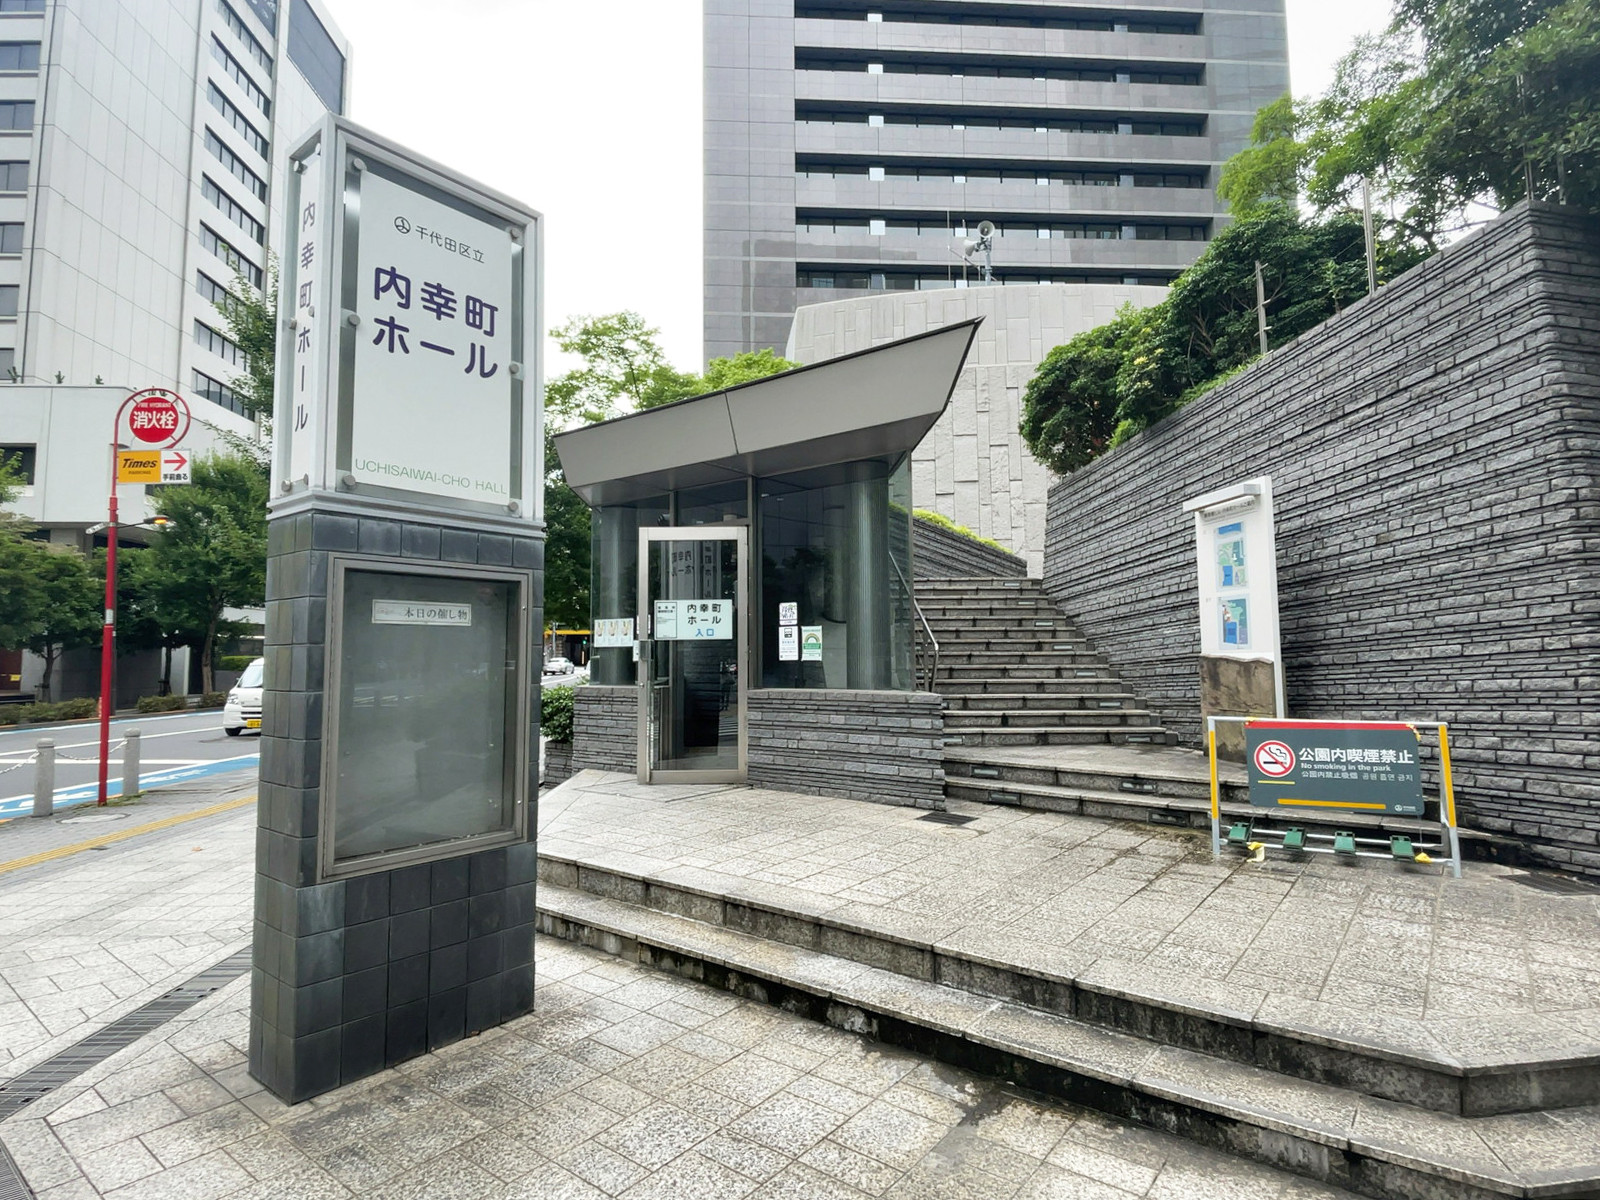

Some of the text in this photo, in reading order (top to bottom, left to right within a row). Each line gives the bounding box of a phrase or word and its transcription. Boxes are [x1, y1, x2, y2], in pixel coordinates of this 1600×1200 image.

[414, 224, 485, 264] 千代田区立
[373, 265, 499, 338] 内幸町
[294, 201, 316, 432] 内幸町ホール
[372, 315, 499, 379] ホール
[133, 410, 176, 429] 消火栓
[122, 458, 158, 469] Times
[354, 458, 508, 495] UCHISAIWAI-CHO HALL
[404, 606, 468, 620] 本日の催し物
[687, 603, 721, 614] 内幸町
[687, 616, 722, 625] ホール
[695, 628, 715, 637] 入口
[1298, 748, 1414, 764] 公園内喫煙禁止
[1313, 763, 1346, 771] smoking
[1373, 764, 1391, 772] park
